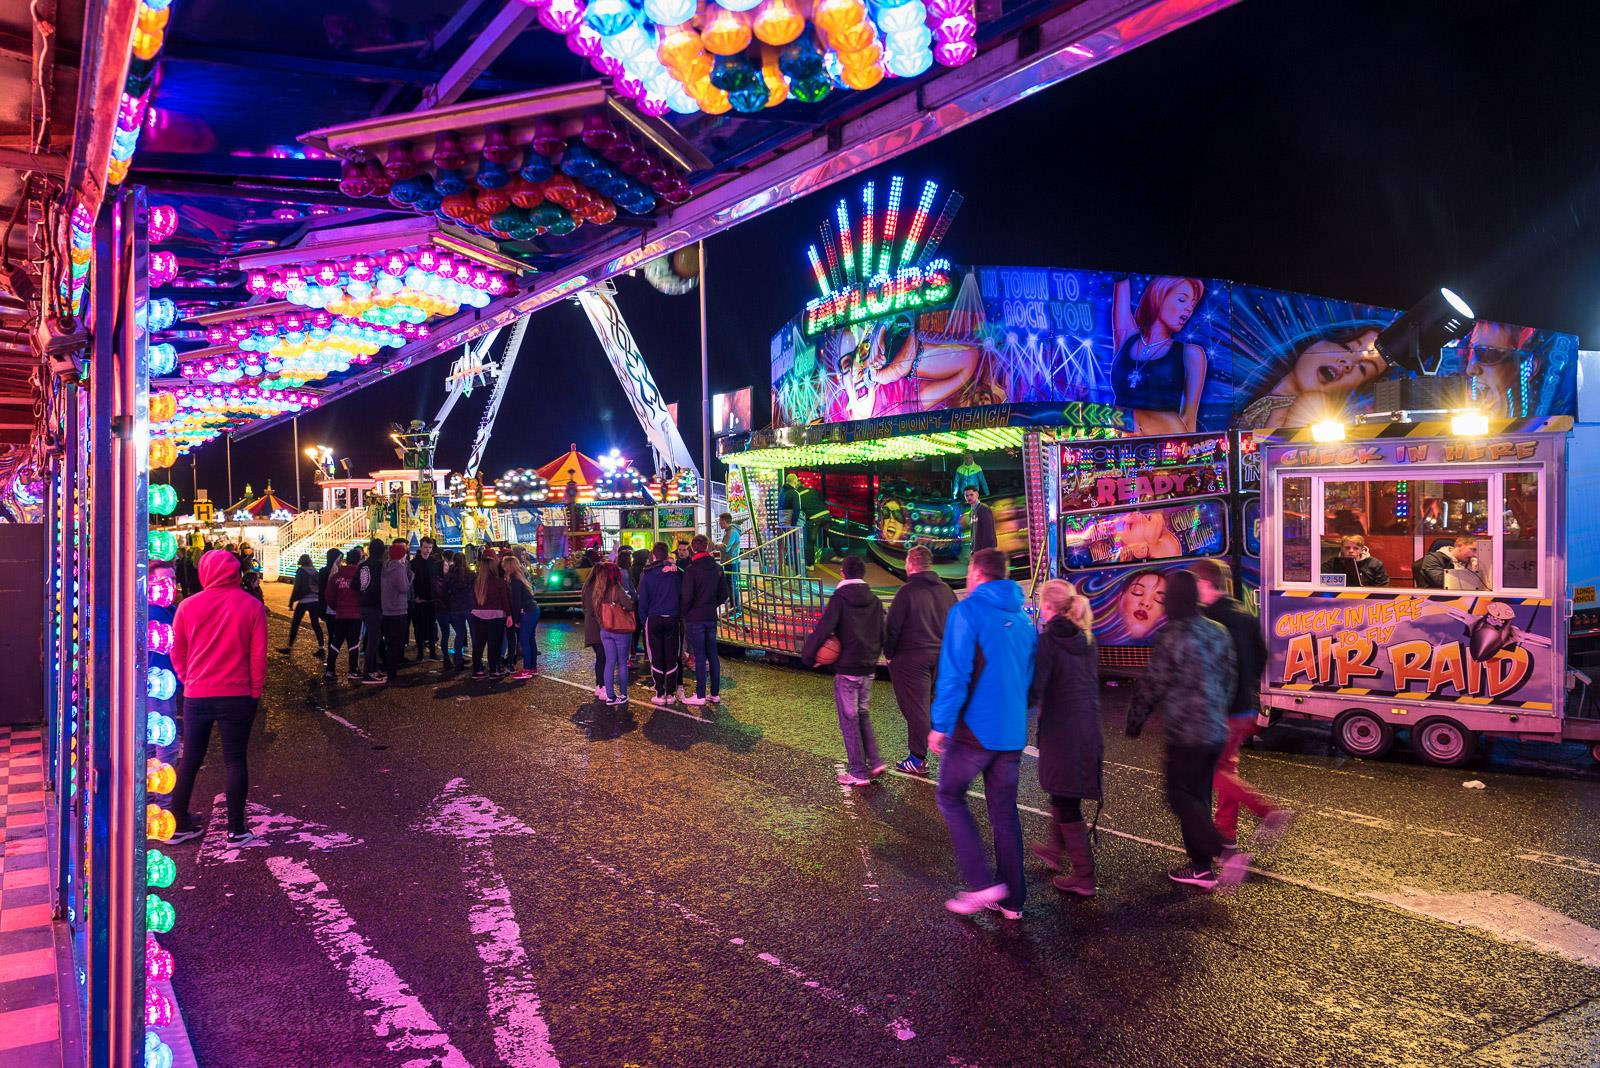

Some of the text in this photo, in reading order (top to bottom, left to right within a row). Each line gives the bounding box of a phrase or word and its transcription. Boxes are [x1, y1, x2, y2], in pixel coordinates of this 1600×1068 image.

[981, 270, 1080, 301] IN TOWN TO
[1003, 300, 1048, 329] ROCK
[1050, 302, 1093, 331] YOU
[853, 420, 892, 439] RIDES
[950, 403, 1011, 430] REACH
[1280, 440, 1538, 465] CHECK IN HERE
[1096, 474, 1190, 505] READY
[197, 506, 210, 520] H
[1276, 598, 1424, 636] CHECK IN HERE
[1338, 625, 1395, 648] TO FLY
[1283, 633, 1531, 698] AIR RAID
